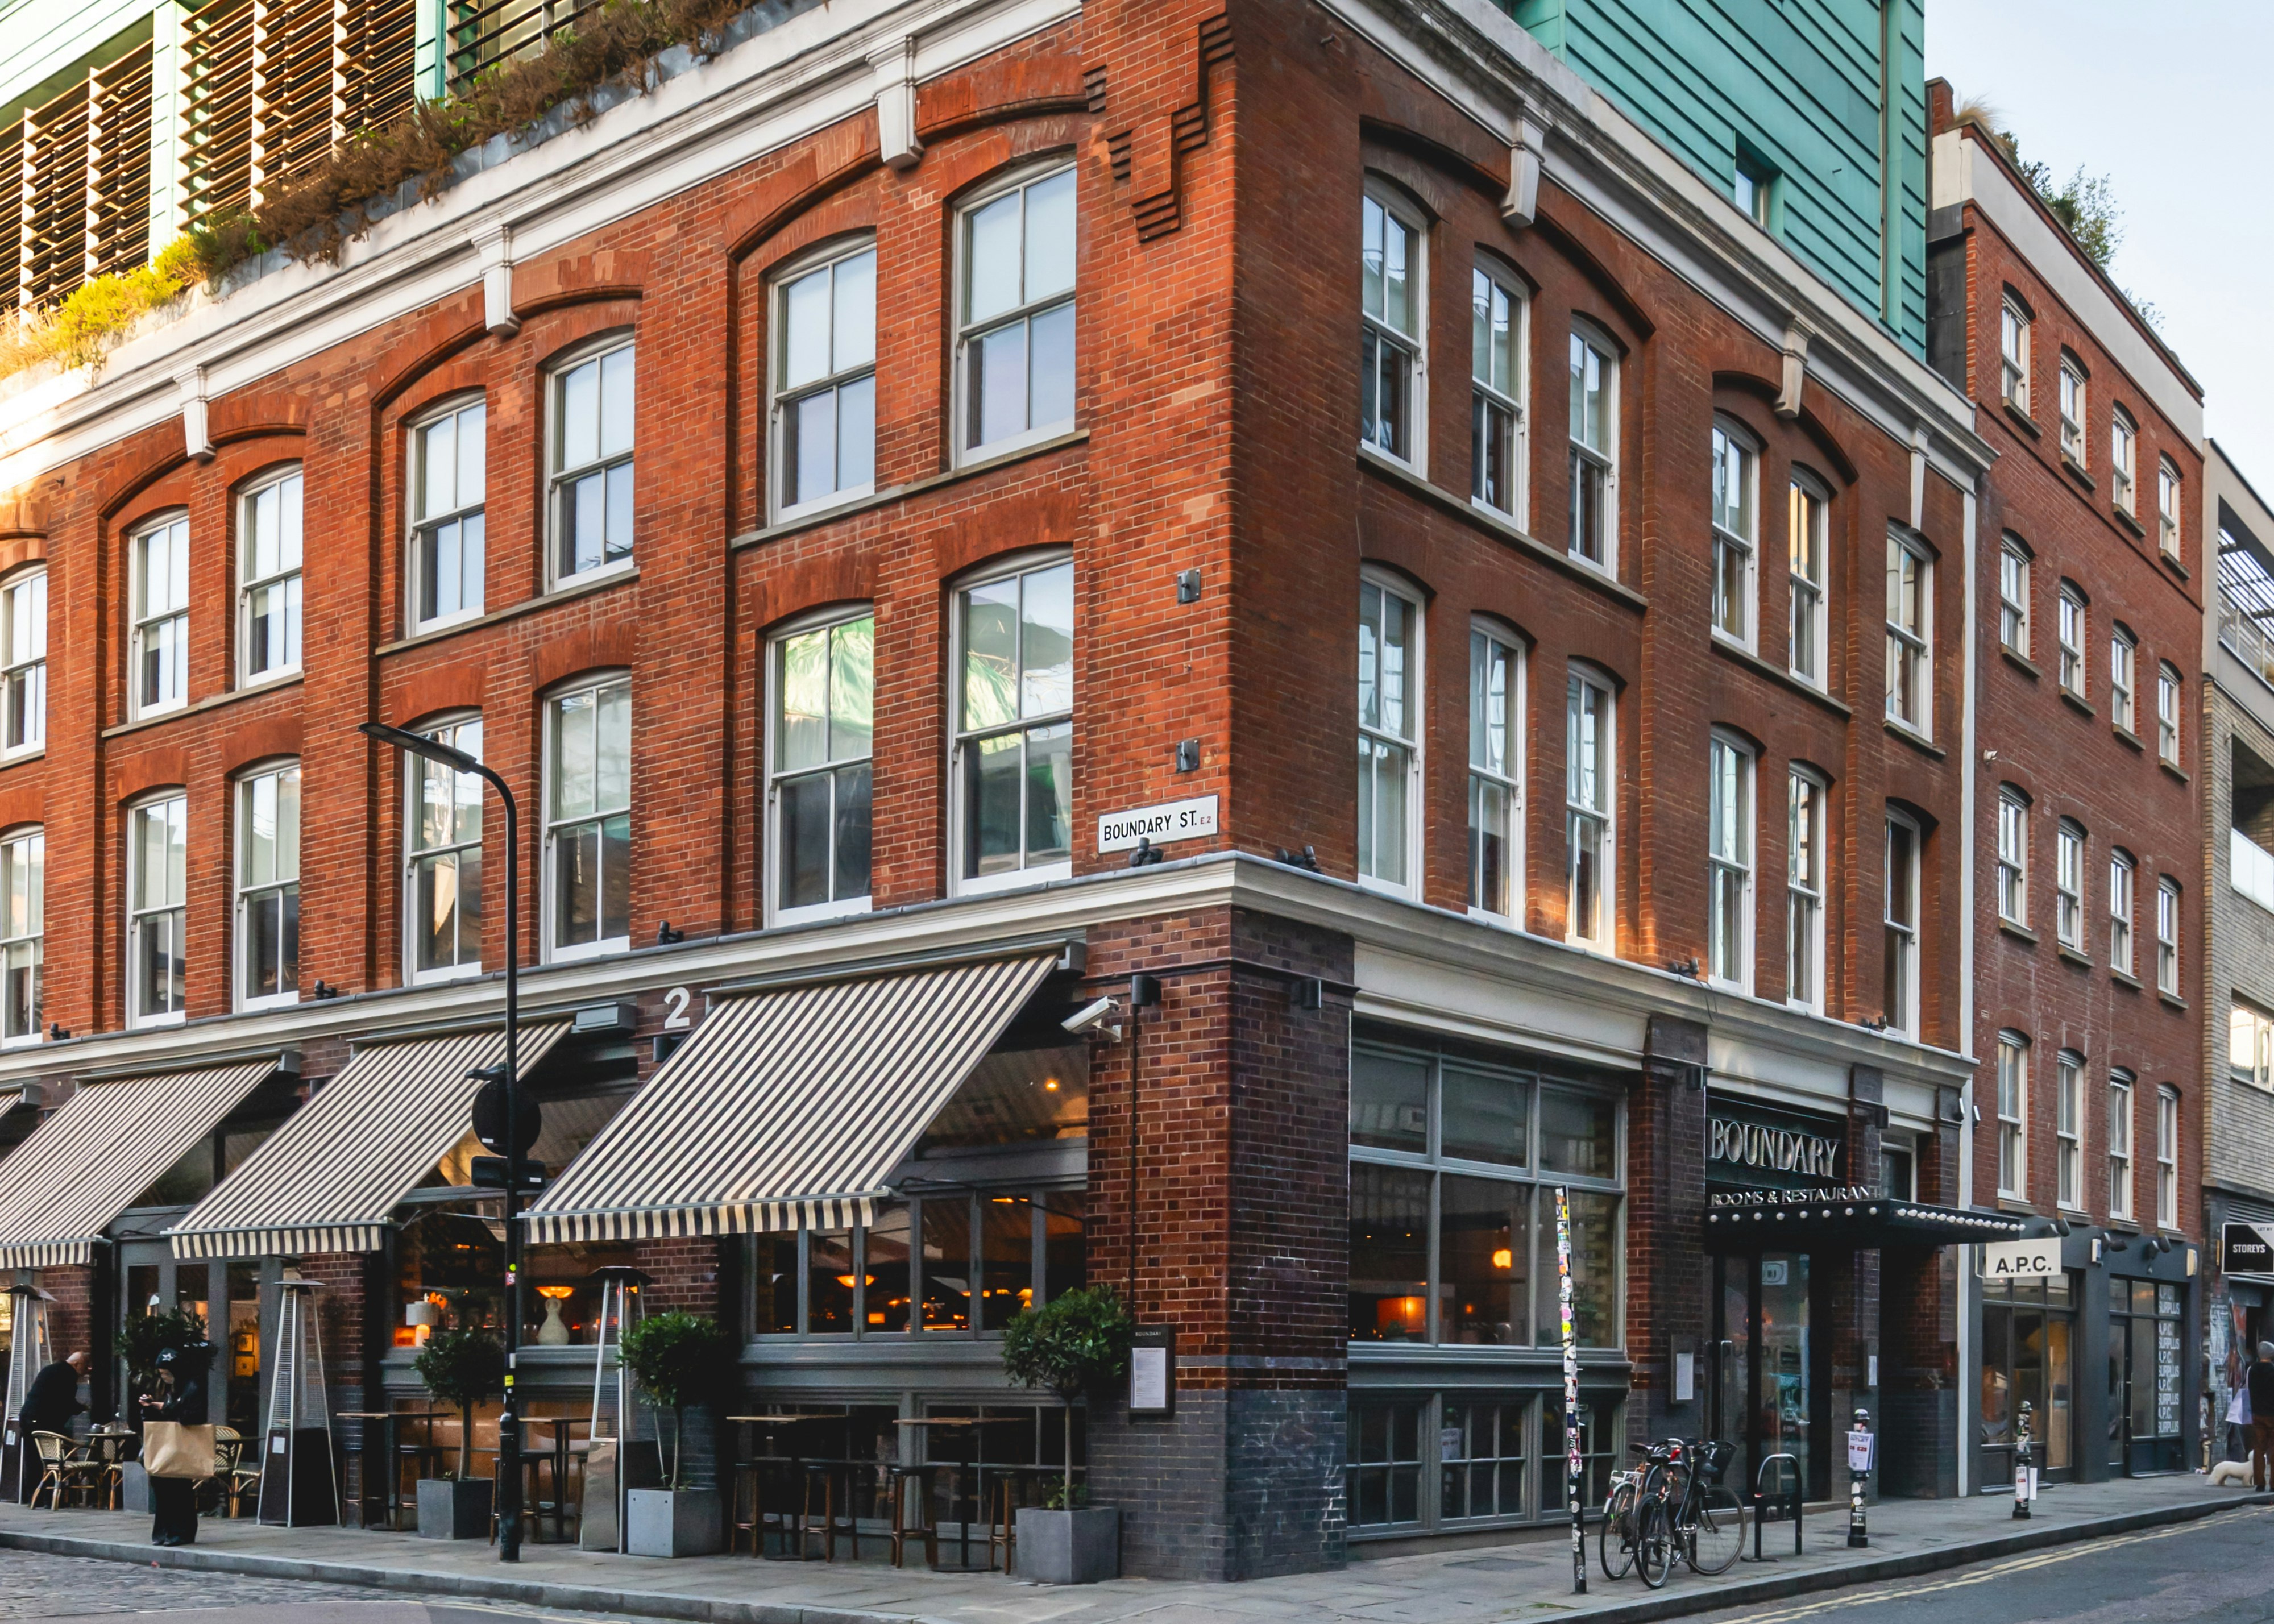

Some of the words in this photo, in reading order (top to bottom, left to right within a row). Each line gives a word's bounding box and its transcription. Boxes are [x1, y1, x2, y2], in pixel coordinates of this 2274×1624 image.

[1104, 815, 1171, 841] BOUNDARY
[1180, 811, 1197, 828] ST.
[664, 987, 690, 1029] 2
[1709, 1119, 1839, 1177] BOUNDARY
[1711, 1191, 1763, 1206] ROOMS
[1767, 1191, 1778, 1203] &
[2232, 1244, 2265, 1253] STOREYS
[1995, 1256, 2052, 1273] A.P.C.
